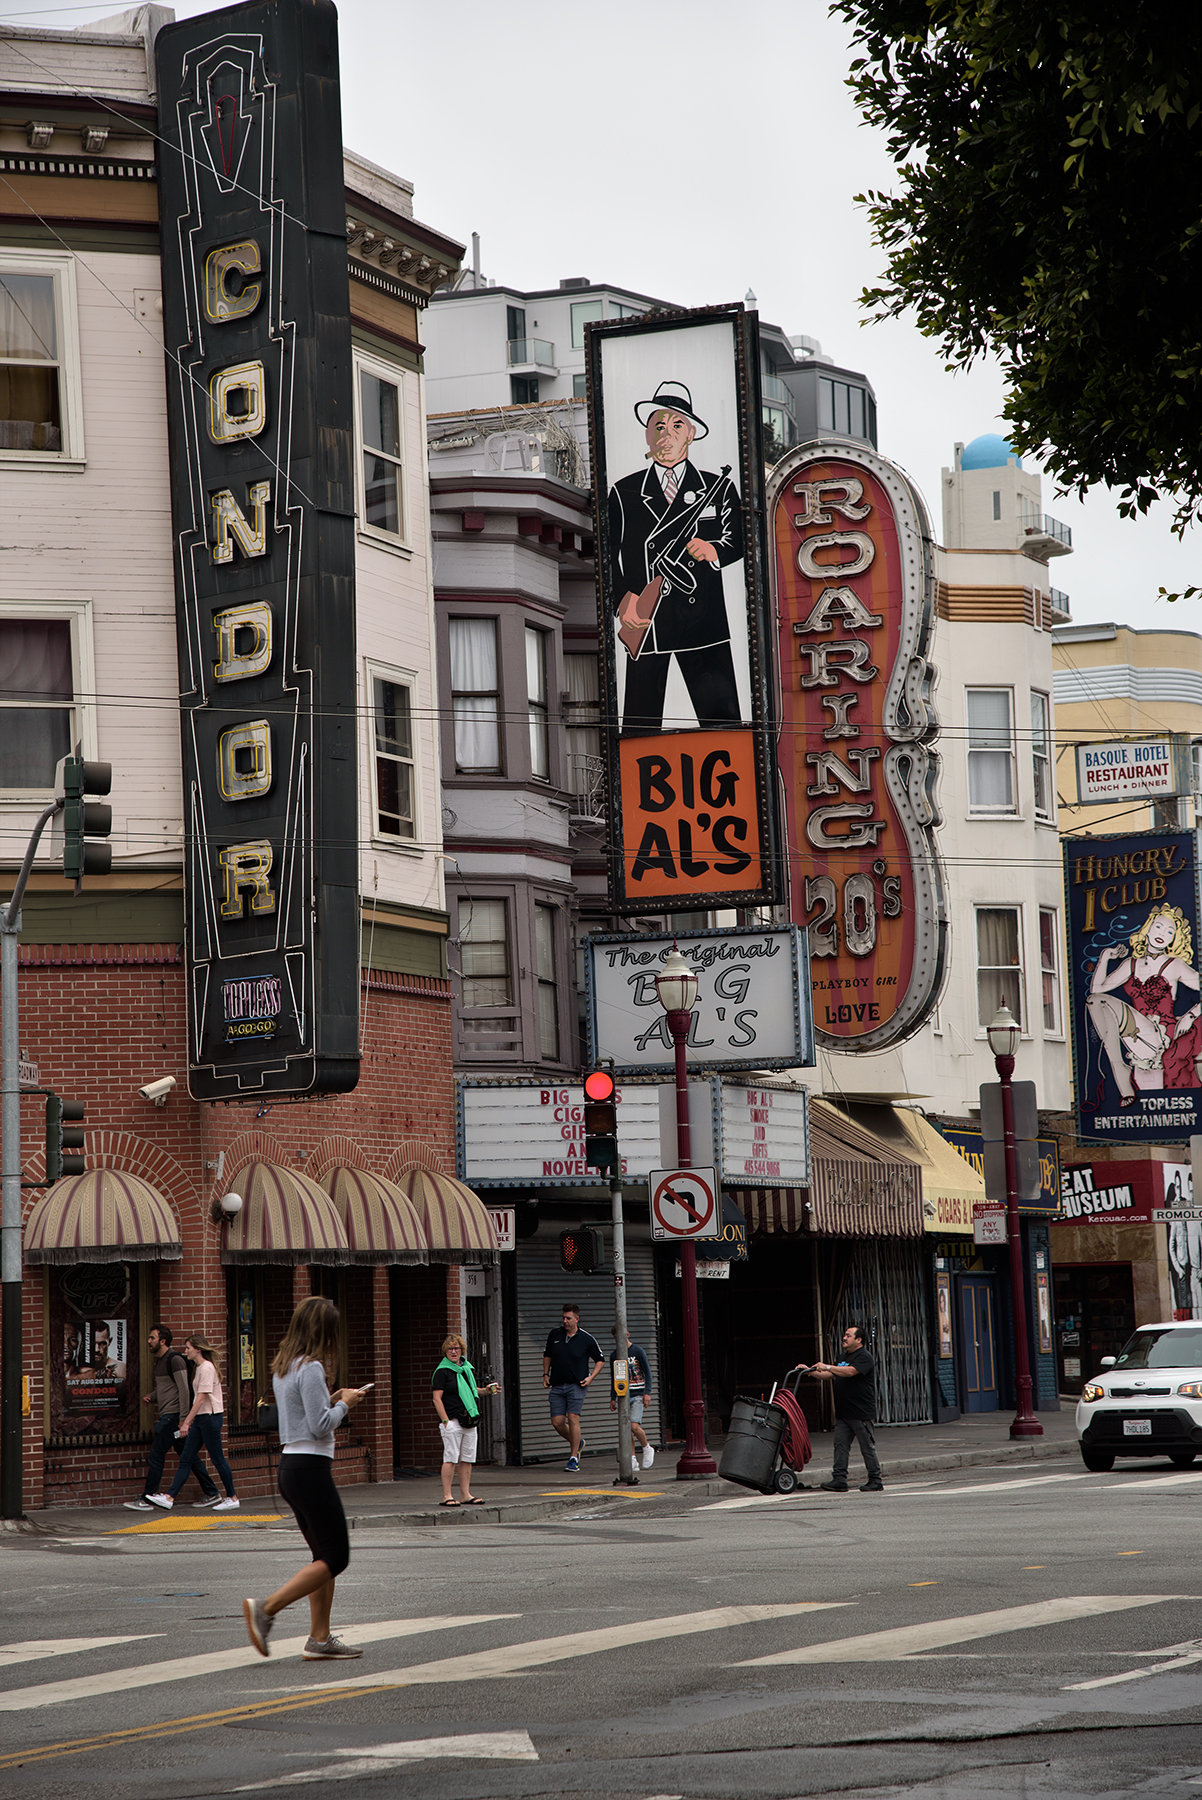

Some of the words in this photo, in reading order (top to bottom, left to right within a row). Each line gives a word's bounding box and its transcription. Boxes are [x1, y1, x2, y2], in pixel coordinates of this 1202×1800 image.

[202, 238, 277, 922] CONDOR
[793, 476, 886, 849] ROARING
[1085, 748, 1127, 768] BASQUE
[1135, 745, 1168, 763] HOTEL
[636, 750, 740, 813] BIG
[1087, 762, 1169, 784] RESTAURANT
[1088, 784, 1119, 793] LUNCH
[1131, 779, 1168, 789] DINNER
[631, 813, 752, 882] AL'S
[1073, 845, 1186, 884] HUNGRY
[1101, 876, 1167, 913] CLUB
[605, 946, 657, 968] The
[659, 937, 780, 967] Original
[812, 977, 869, 990] PLAYBOY
[876, 976, 898, 986] GIRL
[221, 979, 281, 1019] TOPLESS
[825, 1002, 880, 1024] LOVE
[634, 1007, 758, 1051] AL'S
[541, 1090, 569, 1105] BIG
[747, 1090, 757, 1105] BIG
[1140, 1097, 1193, 1110] TOPLESS
[751, 1108, 769, 1124] SMOKE
[1094, 1112, 1197, 1129] ENTERTAINMENT
[754, 1126, 765, 1140] AND
[938, 1197, 961, 1224] CIGARS
[974, 1211, 983, 1219] NO
[938, 1242, 976, 1257] ATM
[708, 1269, 727, 1277] RENT
[71, 1386, 117, 1395] CONDOR
